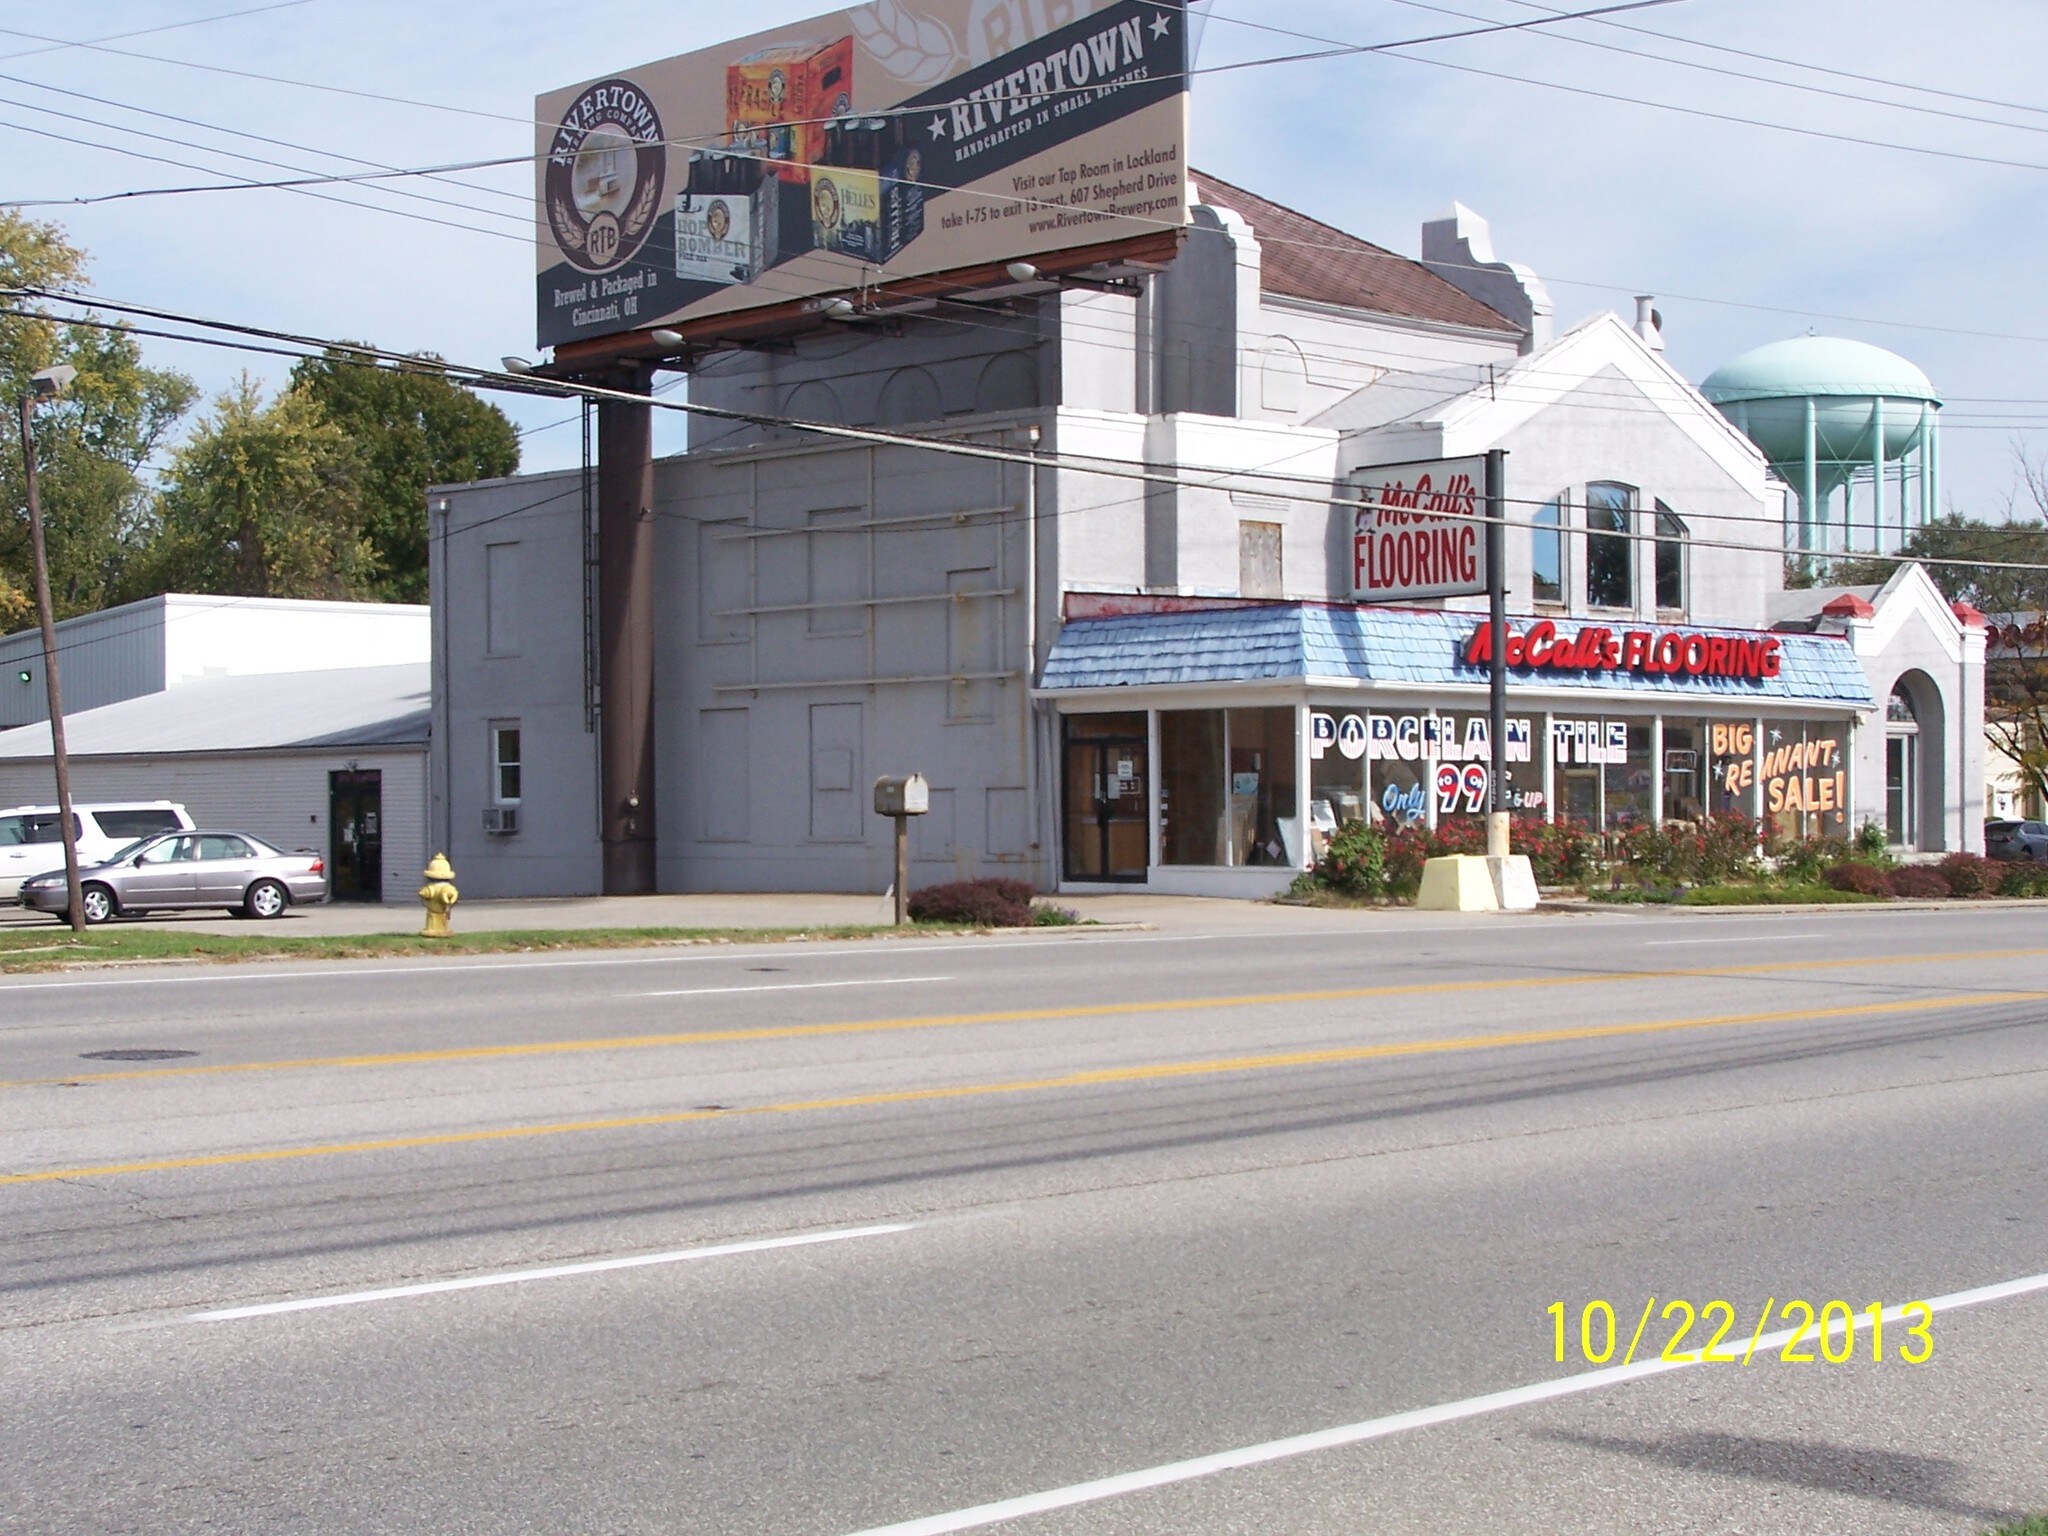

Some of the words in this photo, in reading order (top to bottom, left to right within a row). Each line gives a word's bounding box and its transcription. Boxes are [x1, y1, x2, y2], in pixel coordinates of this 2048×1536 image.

[951, 16, 1144, 142] RIVERTOWN
[552, 86, 660, 167] RIVERTOWN
[606, 109, 646, 146] COMPAN
[954, 117, 1032, 162] HANDCRAFTED
[1036, 109, 1050, 126] IN
[1053, 92, 1092, 118] SMALL
[1097, 66, 1149, 99] BATCHES
[1012, 174, 1035, 192] Visit
[1038, 173, 1056, 187] our
[1058, 167, 1077, 185] Tap
[1080, 163, 1110, 179] Room
[1113, 158, 1124, 173] in
[1127, 144, 1176, 170] Lockland
[941, 212, 963, 230] take
[966, 206, 987, 224] I-75
[990, 207, 1000, 220] to
[1003, 201, 1022, 218] exit
[1070, 187, 1089, 204] 607
[1093, 175, 1144, 200] Shepherd
[1147, 172, 1177, 189] Drive
[591, 225, 616, 254] RTB
[554, 282, 587, 308] Brewed
[590, 279, 598, 299] &
[601, 269, 644, 297] Packaged
[647, 268, 658, 287] in
[572, 299, 620, 327] Cincinnati,
[624, 295, 638, 316] OH
[1377, 473, 1477, 527] McCall's
[1354, 525, 1477, 590] FLOORING
[1466, 620, 1620, 670] McCall's
[1623, 631, 1781, 678] FLOORING
[1310, 712, 1531, 762] PORCELAN
[1552, 720, 1628, 764] TILE
[1712, 724, 1753, 756] BIG
[1382, 782, 1426, 820] Only
[1436, 763, 1488, 813] 99
[1523, 791, 1543, 808] UP
[1768, 770, 1844, 824] SALE!
